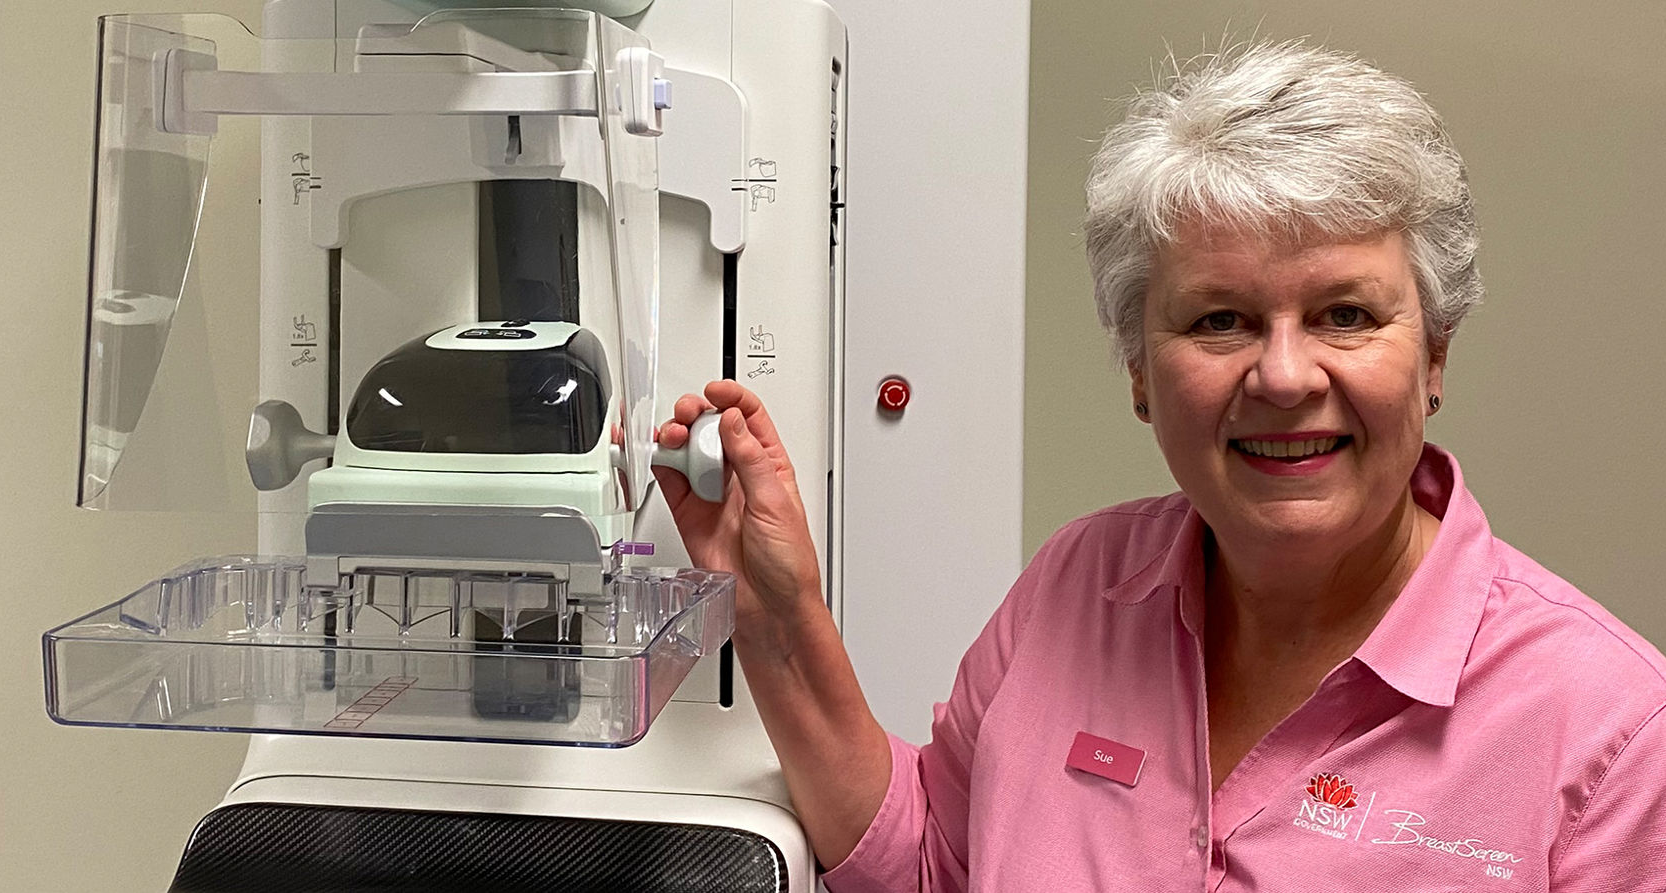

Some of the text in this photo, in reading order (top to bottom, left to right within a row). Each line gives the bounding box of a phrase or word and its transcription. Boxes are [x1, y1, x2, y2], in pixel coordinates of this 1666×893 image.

[1093, 749, 1114, 765] Sue
[1298, 799, 1353, 831] NSW
[1371, 809, 1523, 864] BreastScreen
[1486, 863, 1514, 880] NSW
